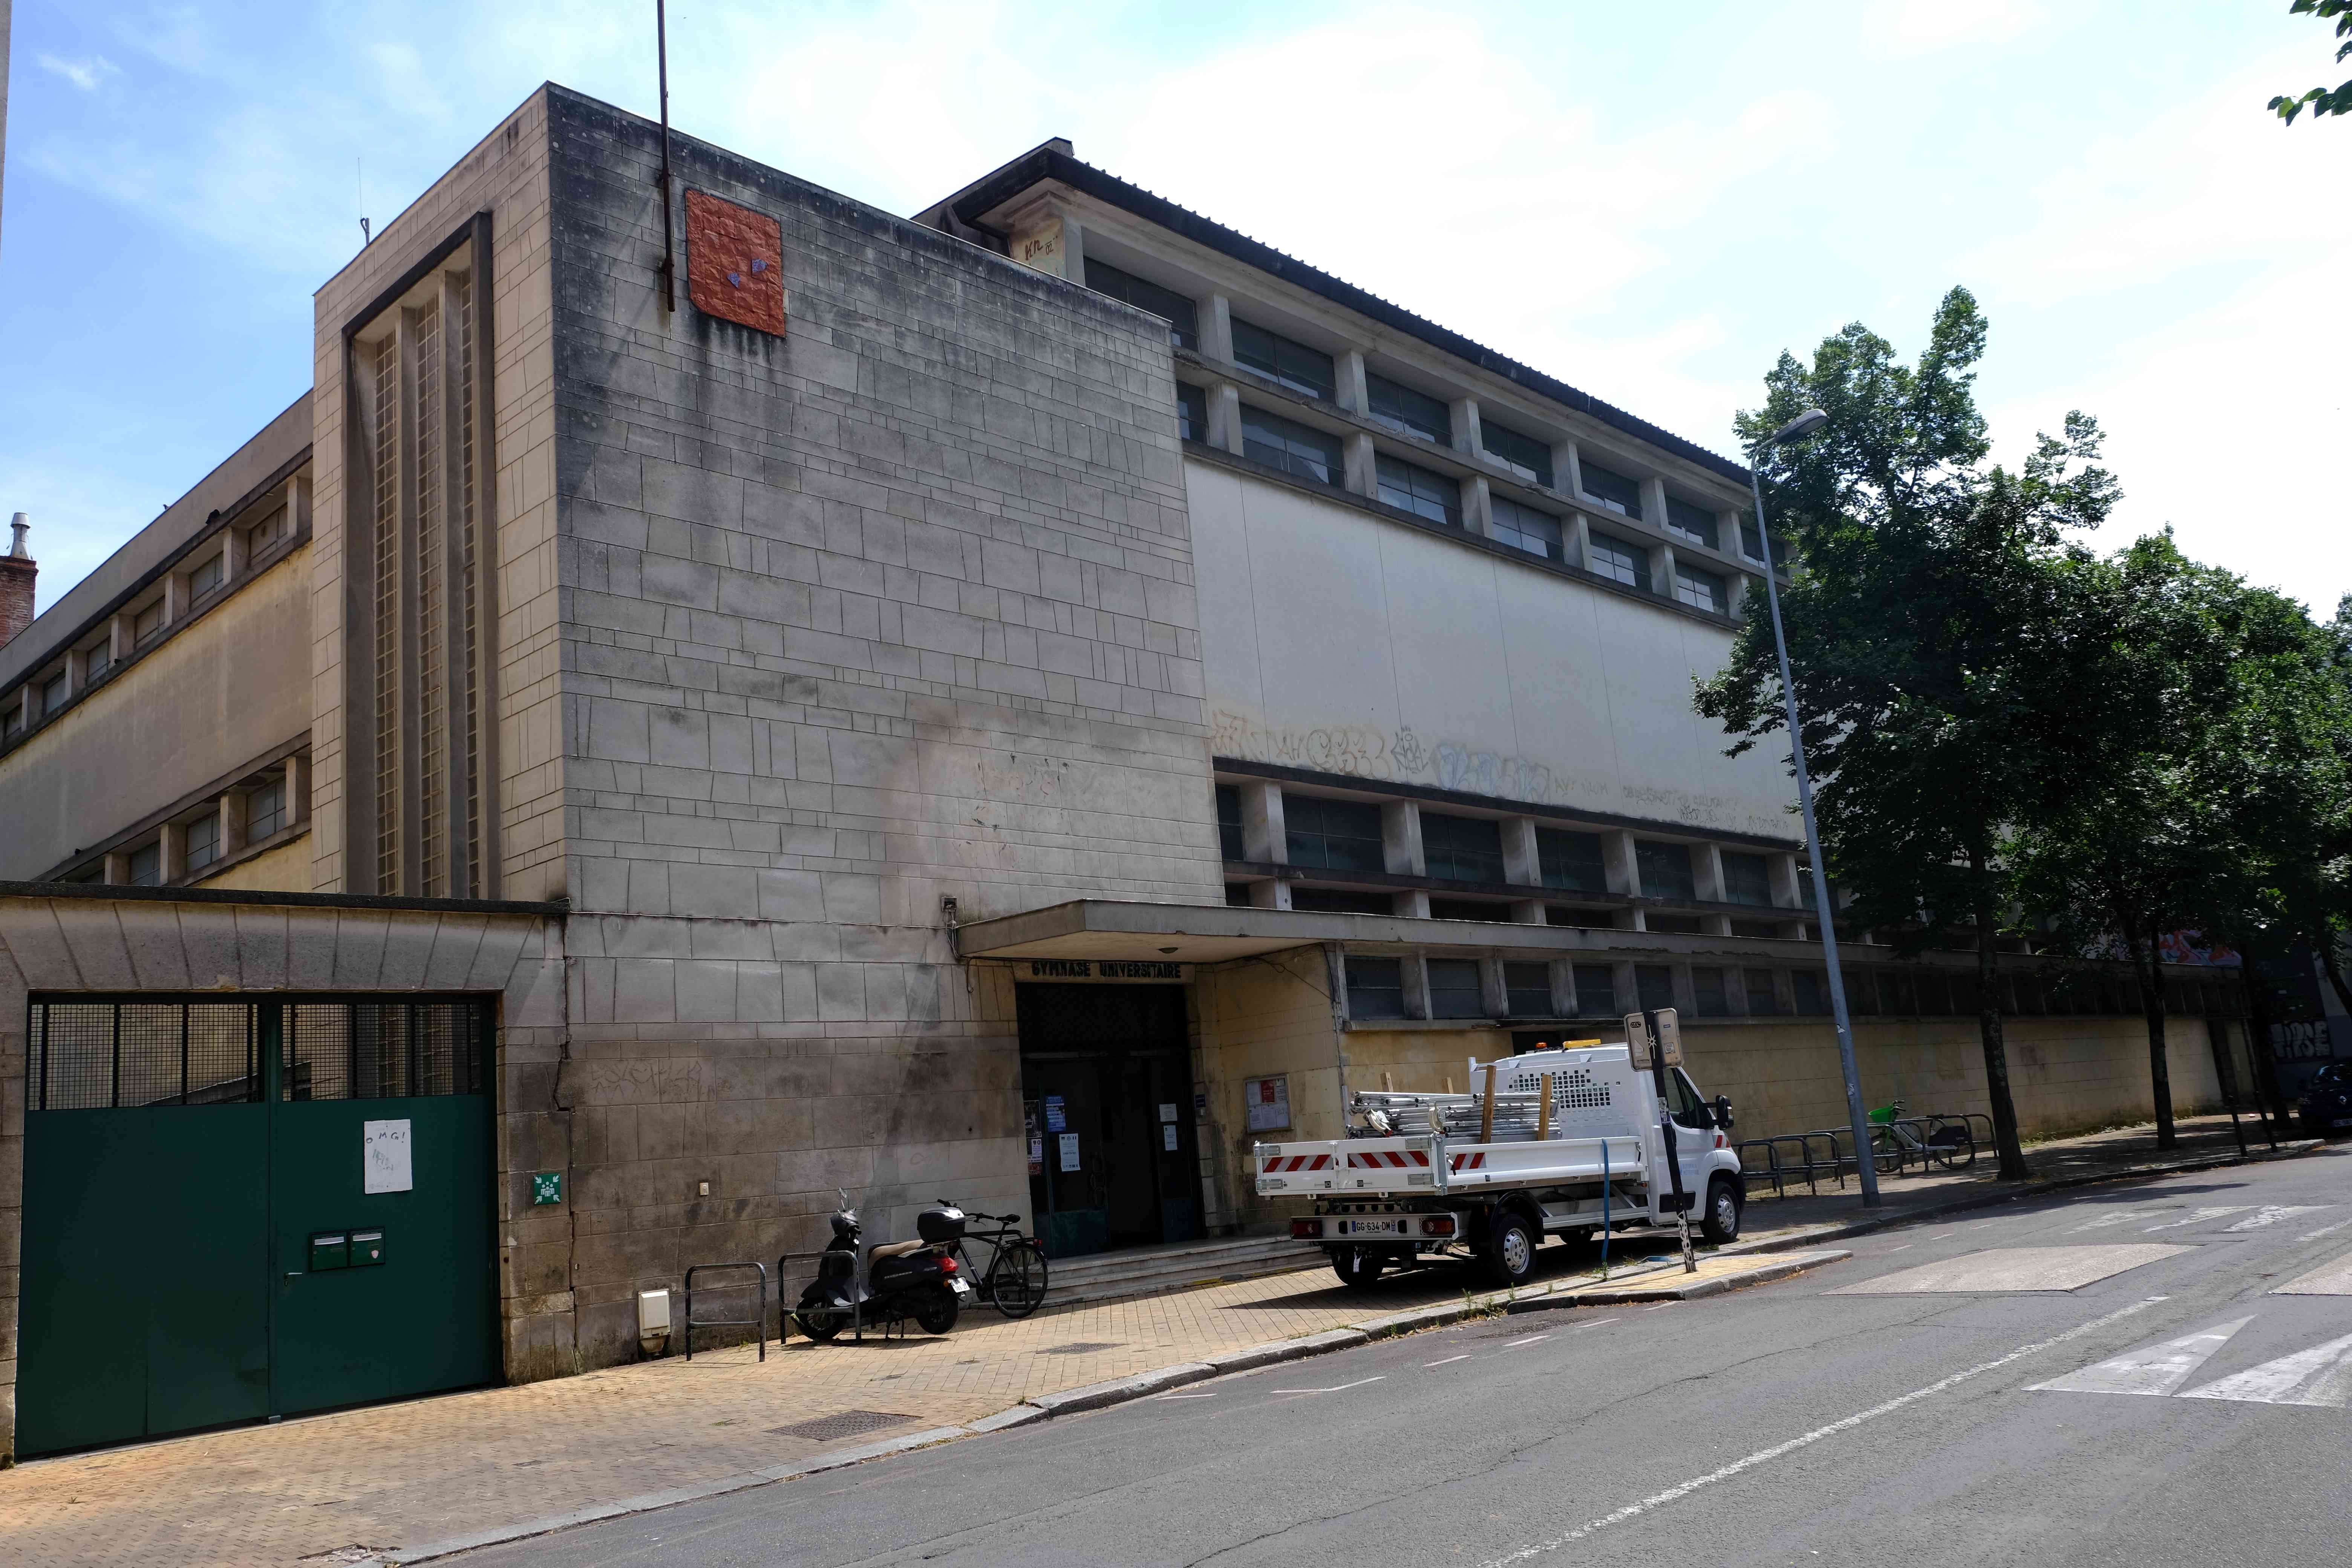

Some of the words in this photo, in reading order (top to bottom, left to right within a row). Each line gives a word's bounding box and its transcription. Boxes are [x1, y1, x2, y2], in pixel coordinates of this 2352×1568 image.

[1031, 961, 1091, 977] GYMNASE
[1099, 962, 1181, 978] UNIVERSITAIRE
[1357, 1222, 1390, 1231] GG-634-DM
